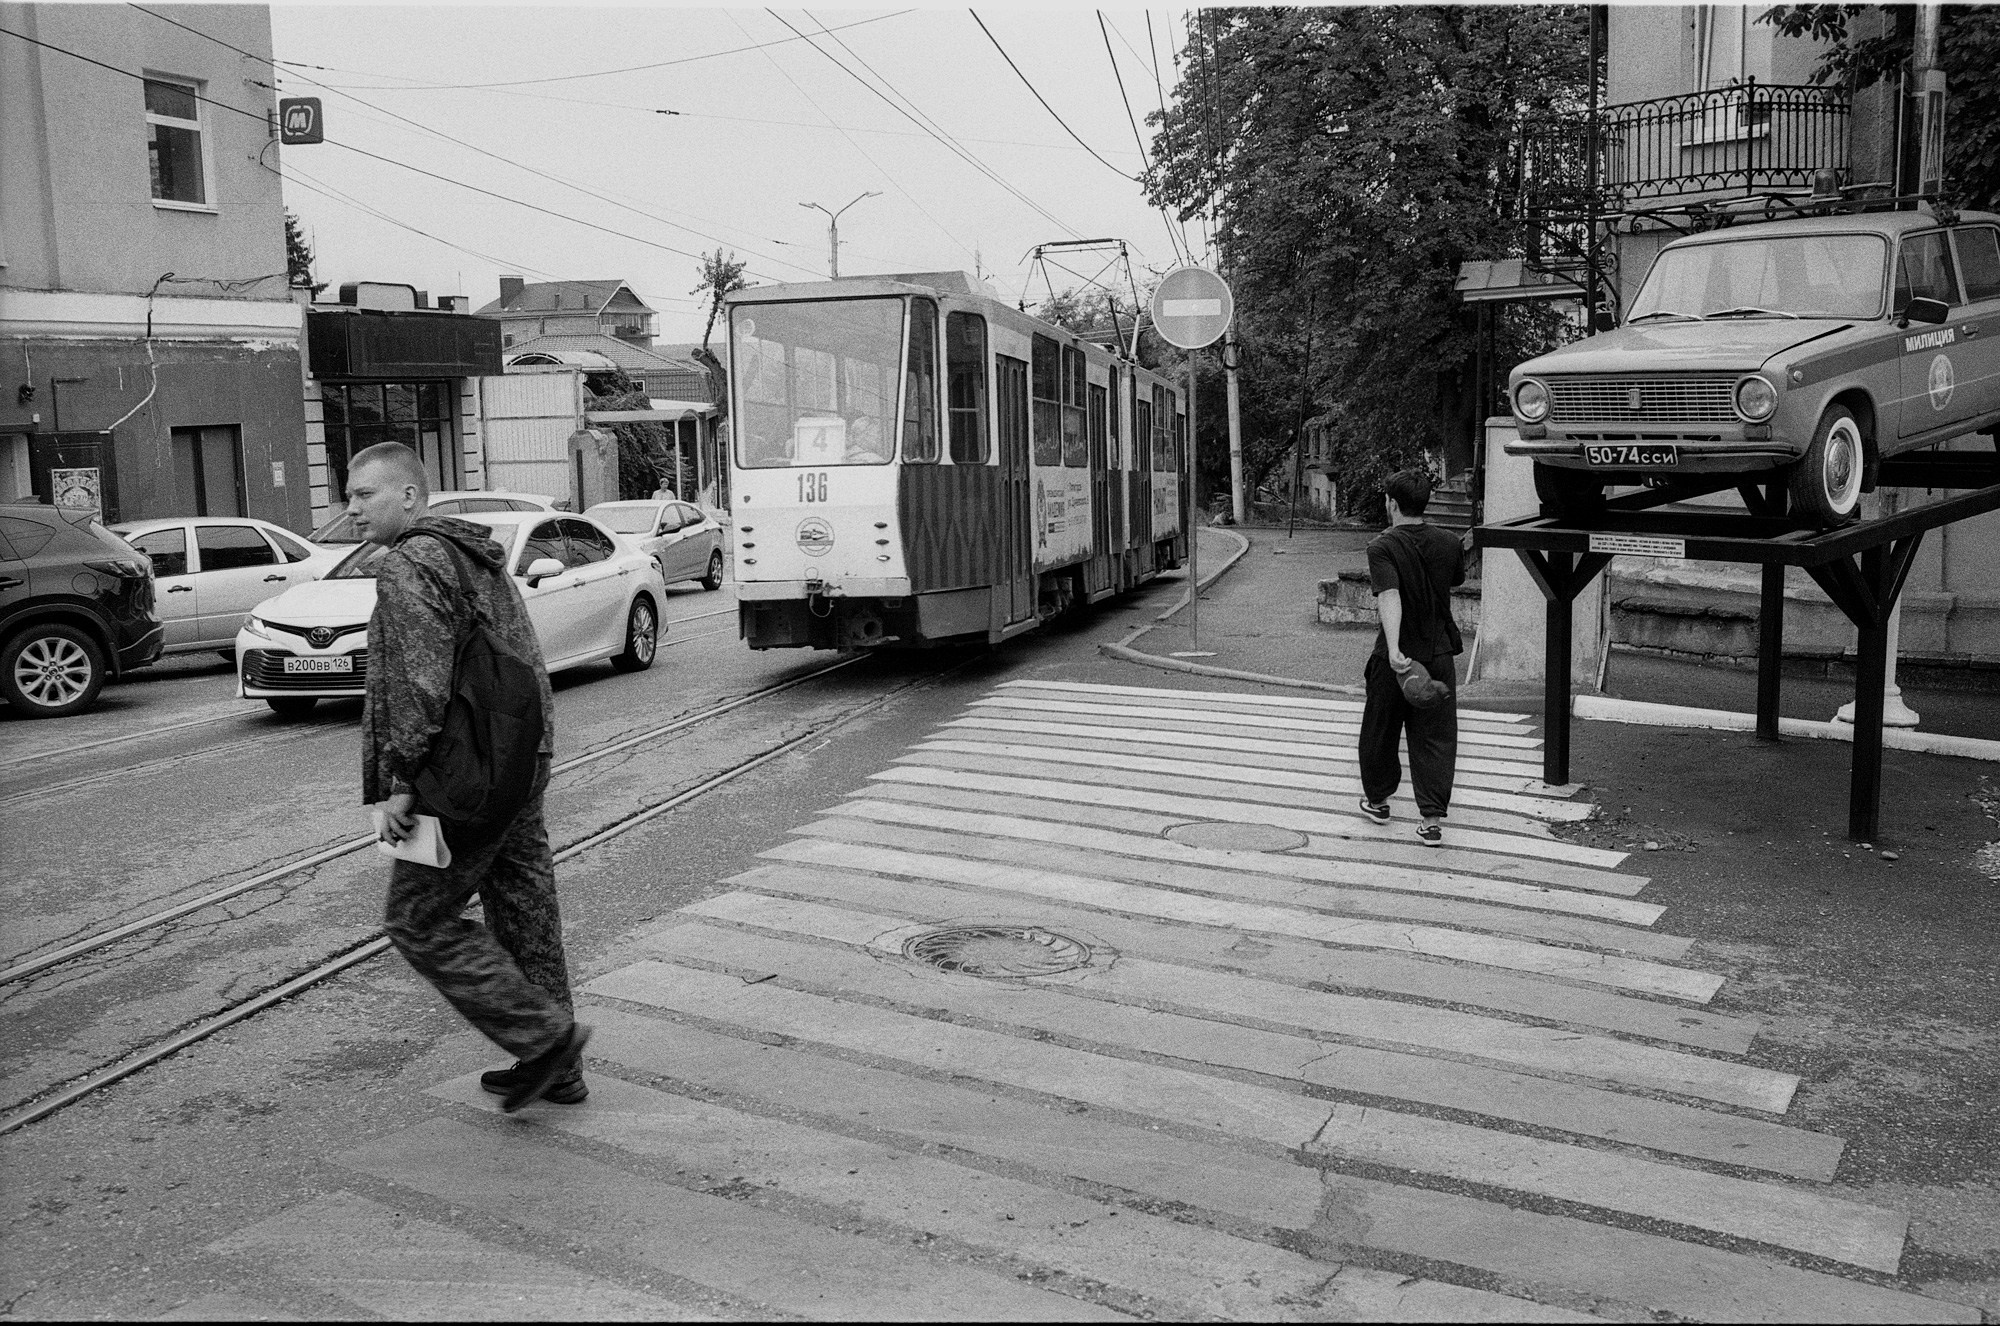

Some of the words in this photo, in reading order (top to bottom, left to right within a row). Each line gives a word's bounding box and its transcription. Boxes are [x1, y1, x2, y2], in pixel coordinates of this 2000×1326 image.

[1905, 328, 1955, 352] МИЛИЦИЯ
[812, 427, 828, 452] 4
[797, 472, 828, 503] 136
[332, 658, 349, 668] 126
